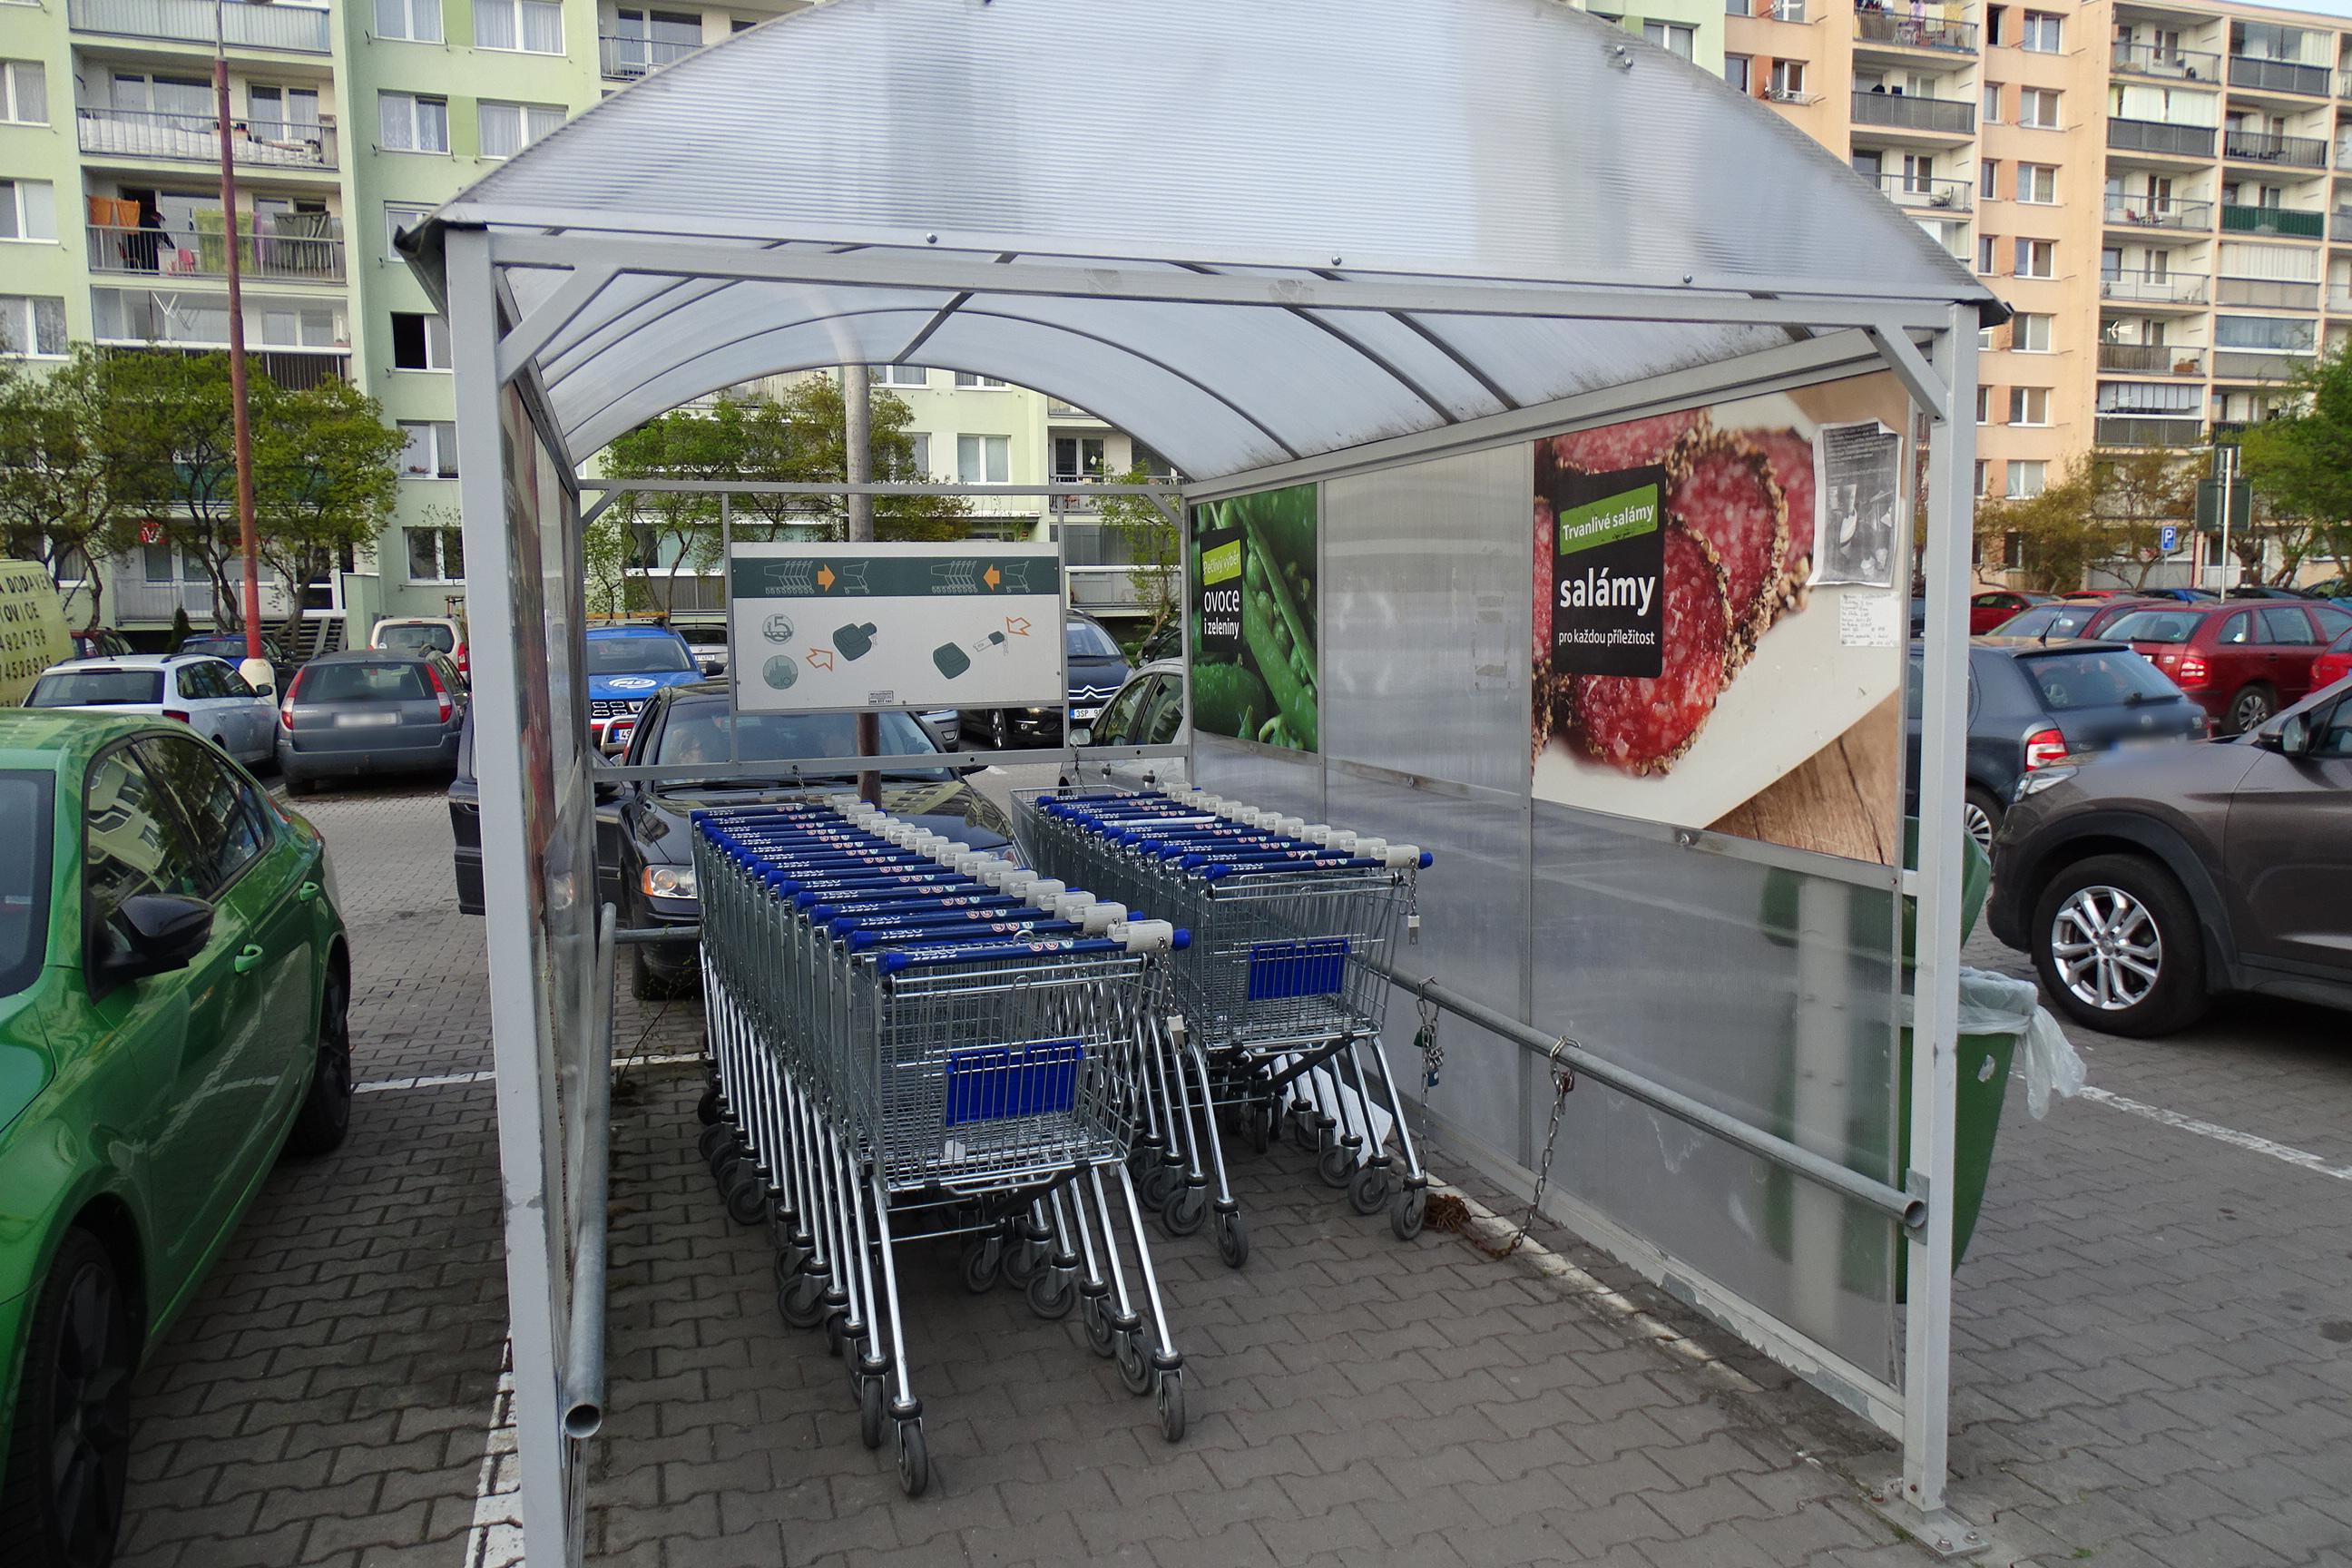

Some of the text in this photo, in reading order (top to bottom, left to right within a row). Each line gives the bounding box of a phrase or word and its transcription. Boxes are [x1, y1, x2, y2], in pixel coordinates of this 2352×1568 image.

[1563, 505, 1654, 541] Trvanlivé salámy
[2164, 529, 2173, 543] P
[1204, 590, 1240, 612] ovoce
[1560, 567, 1655, 617] salámy
[1203, 617, 1240, 640] i zeleniny
[1559, 629, 1655, 647] pro každou příležitost
